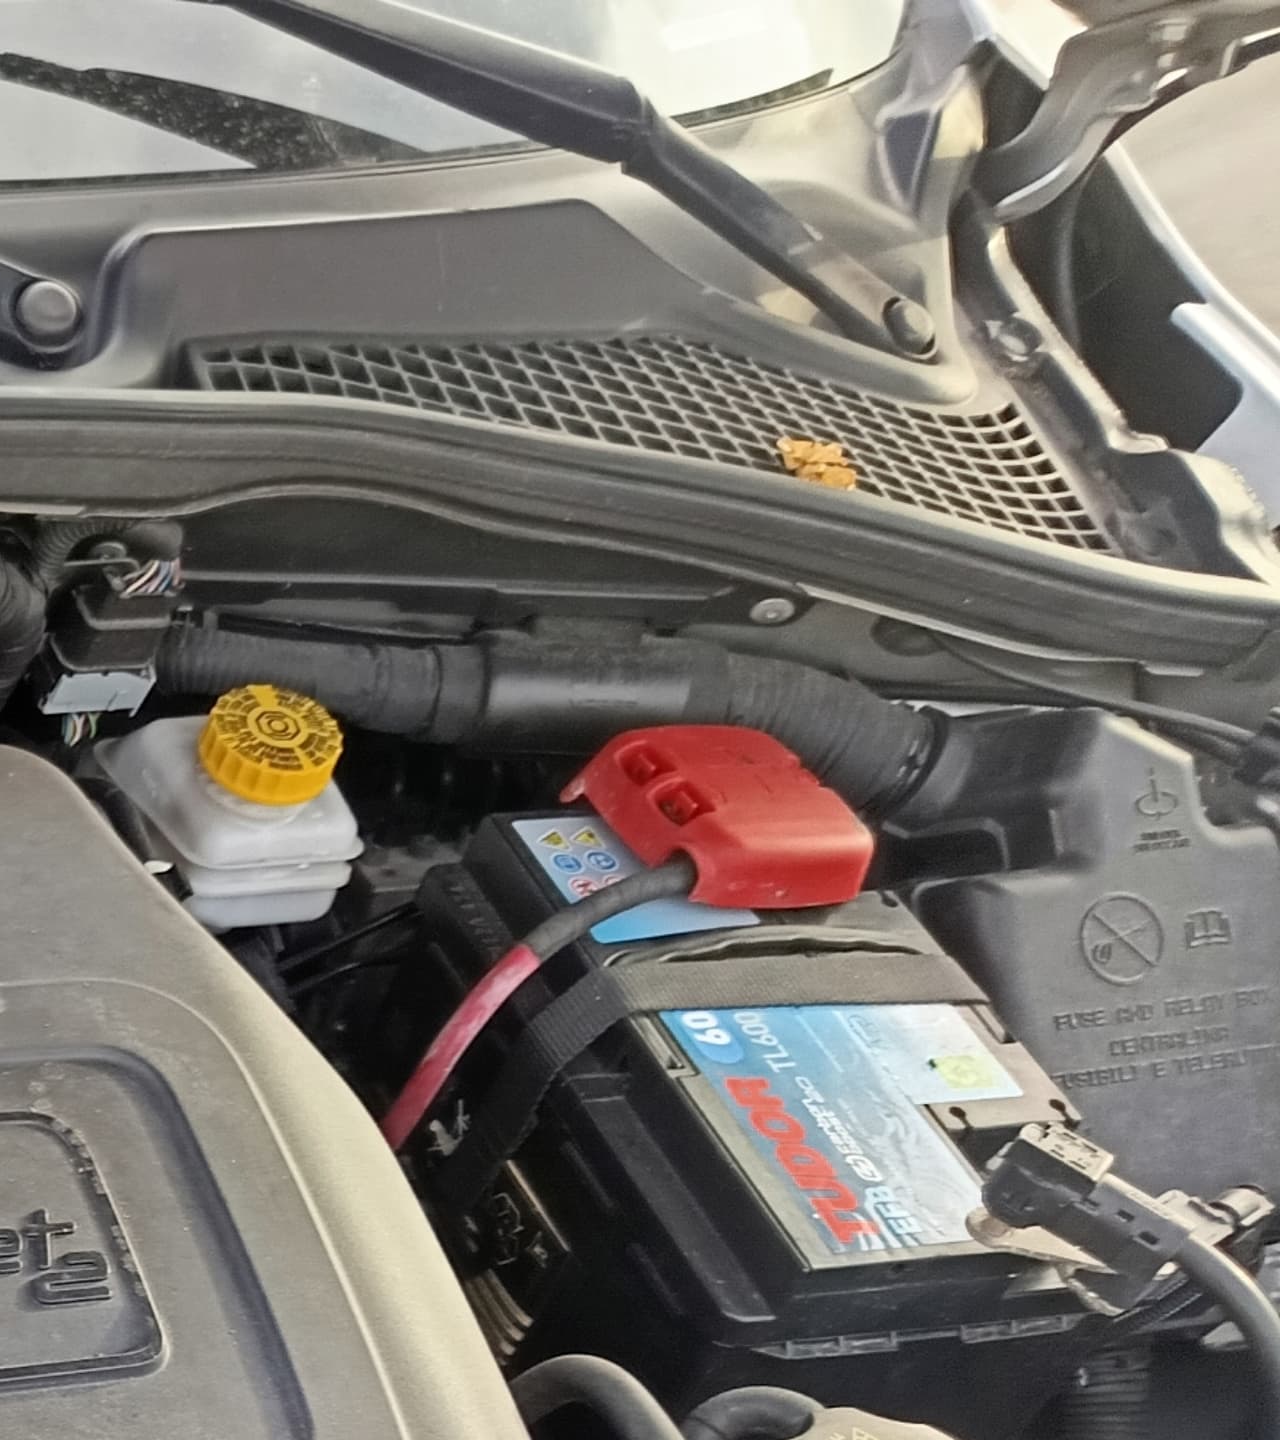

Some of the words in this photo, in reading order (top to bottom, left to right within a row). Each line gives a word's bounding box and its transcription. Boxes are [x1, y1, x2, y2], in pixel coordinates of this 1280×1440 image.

[682, 1010, 731, 1046] 60
[1052, 1009, 1106, 1031] FUSE
[1115, 1003, 1154, 1024] AND
[1163, 993, 1226, 1018] RELAY
[1151, 1060, 1168, 1078] E
[723, 1076, 881, 1245] TUDOR
[865, 1185, 922, 1236] EFB
